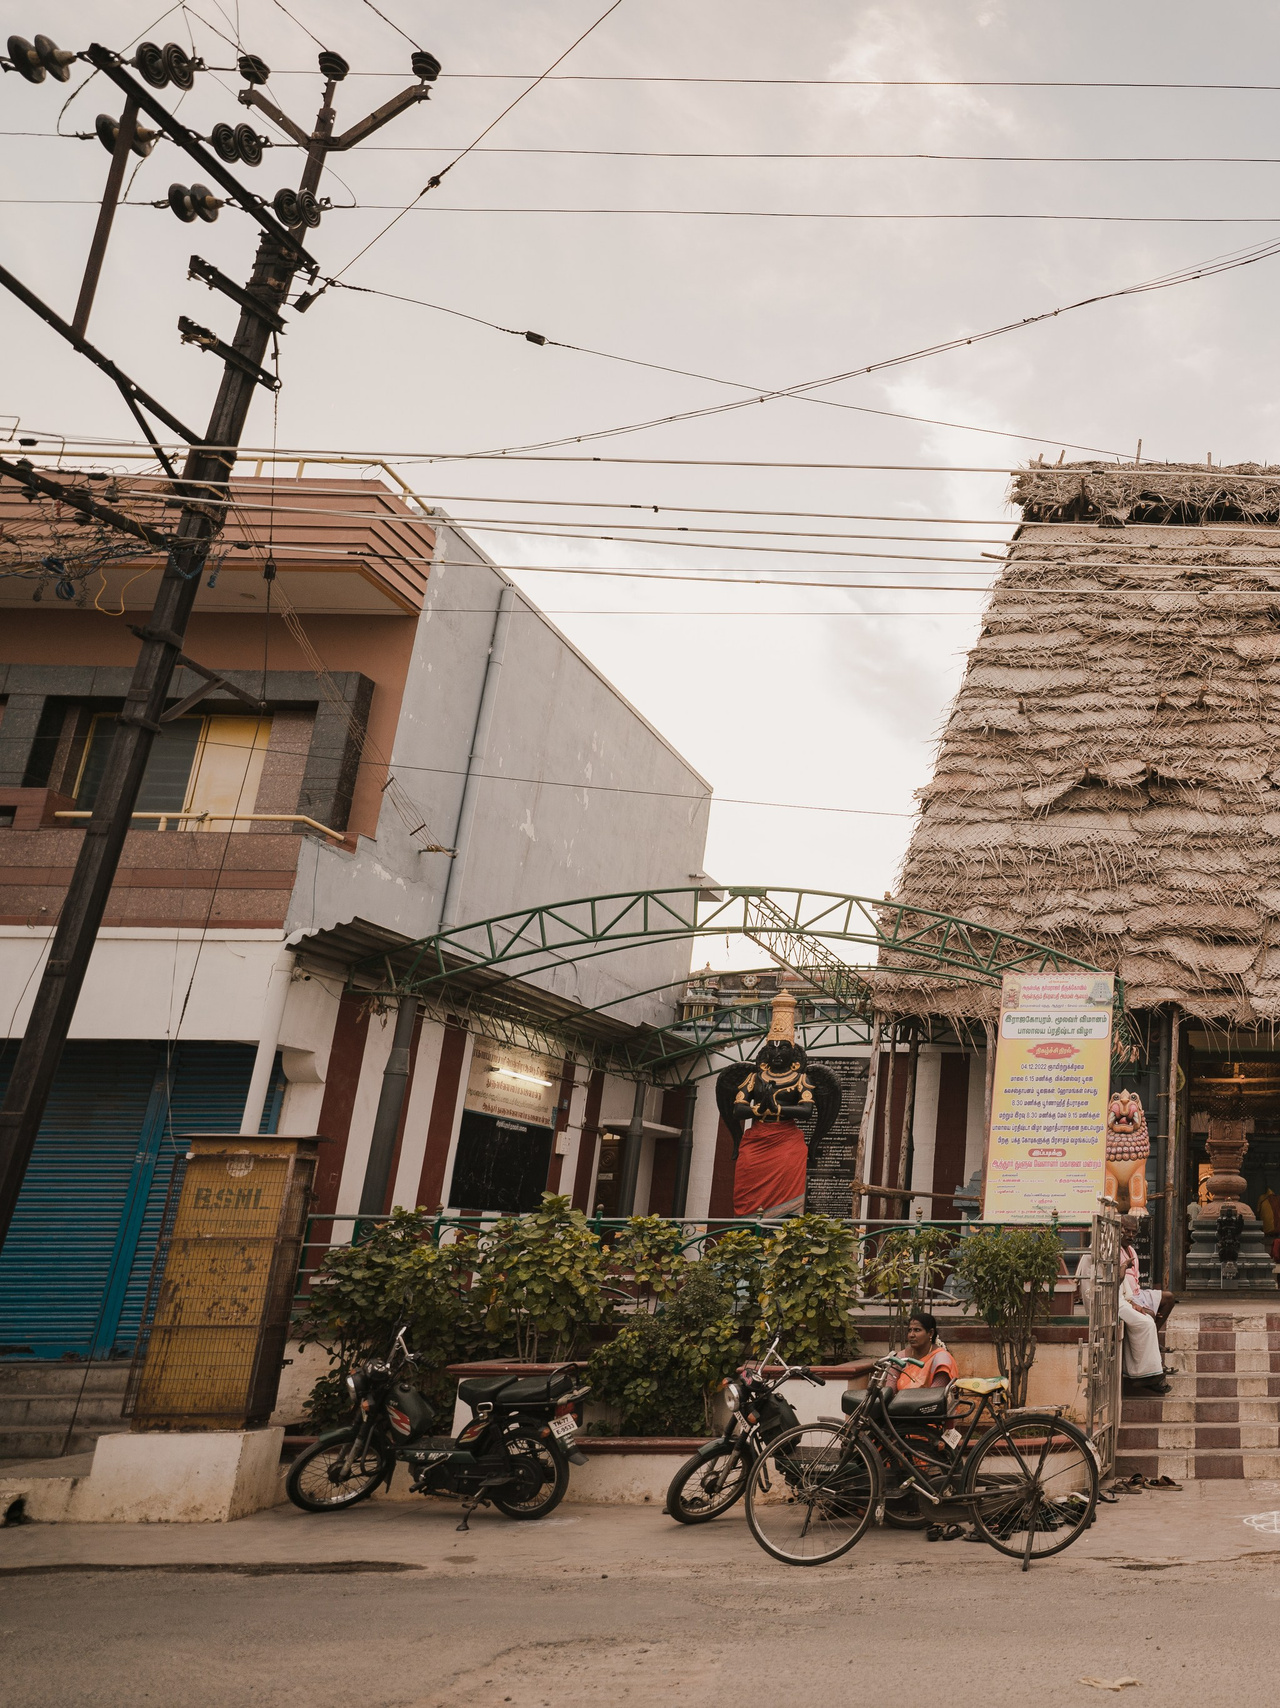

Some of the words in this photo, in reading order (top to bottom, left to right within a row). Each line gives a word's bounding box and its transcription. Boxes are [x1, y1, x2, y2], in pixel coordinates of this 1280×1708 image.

[1055, 1015, 1077, 1024] மூலவர்
[1079, 1014, 1107, 1023] விமானம்
[1076, 1026, 1093, 1036] விழா
[1032, 1149, 1063, 1157] இப்படிக்கு
[193, 1187, 270, 1209] BSNL
[553, 1417, 570, 1428] TN-77
